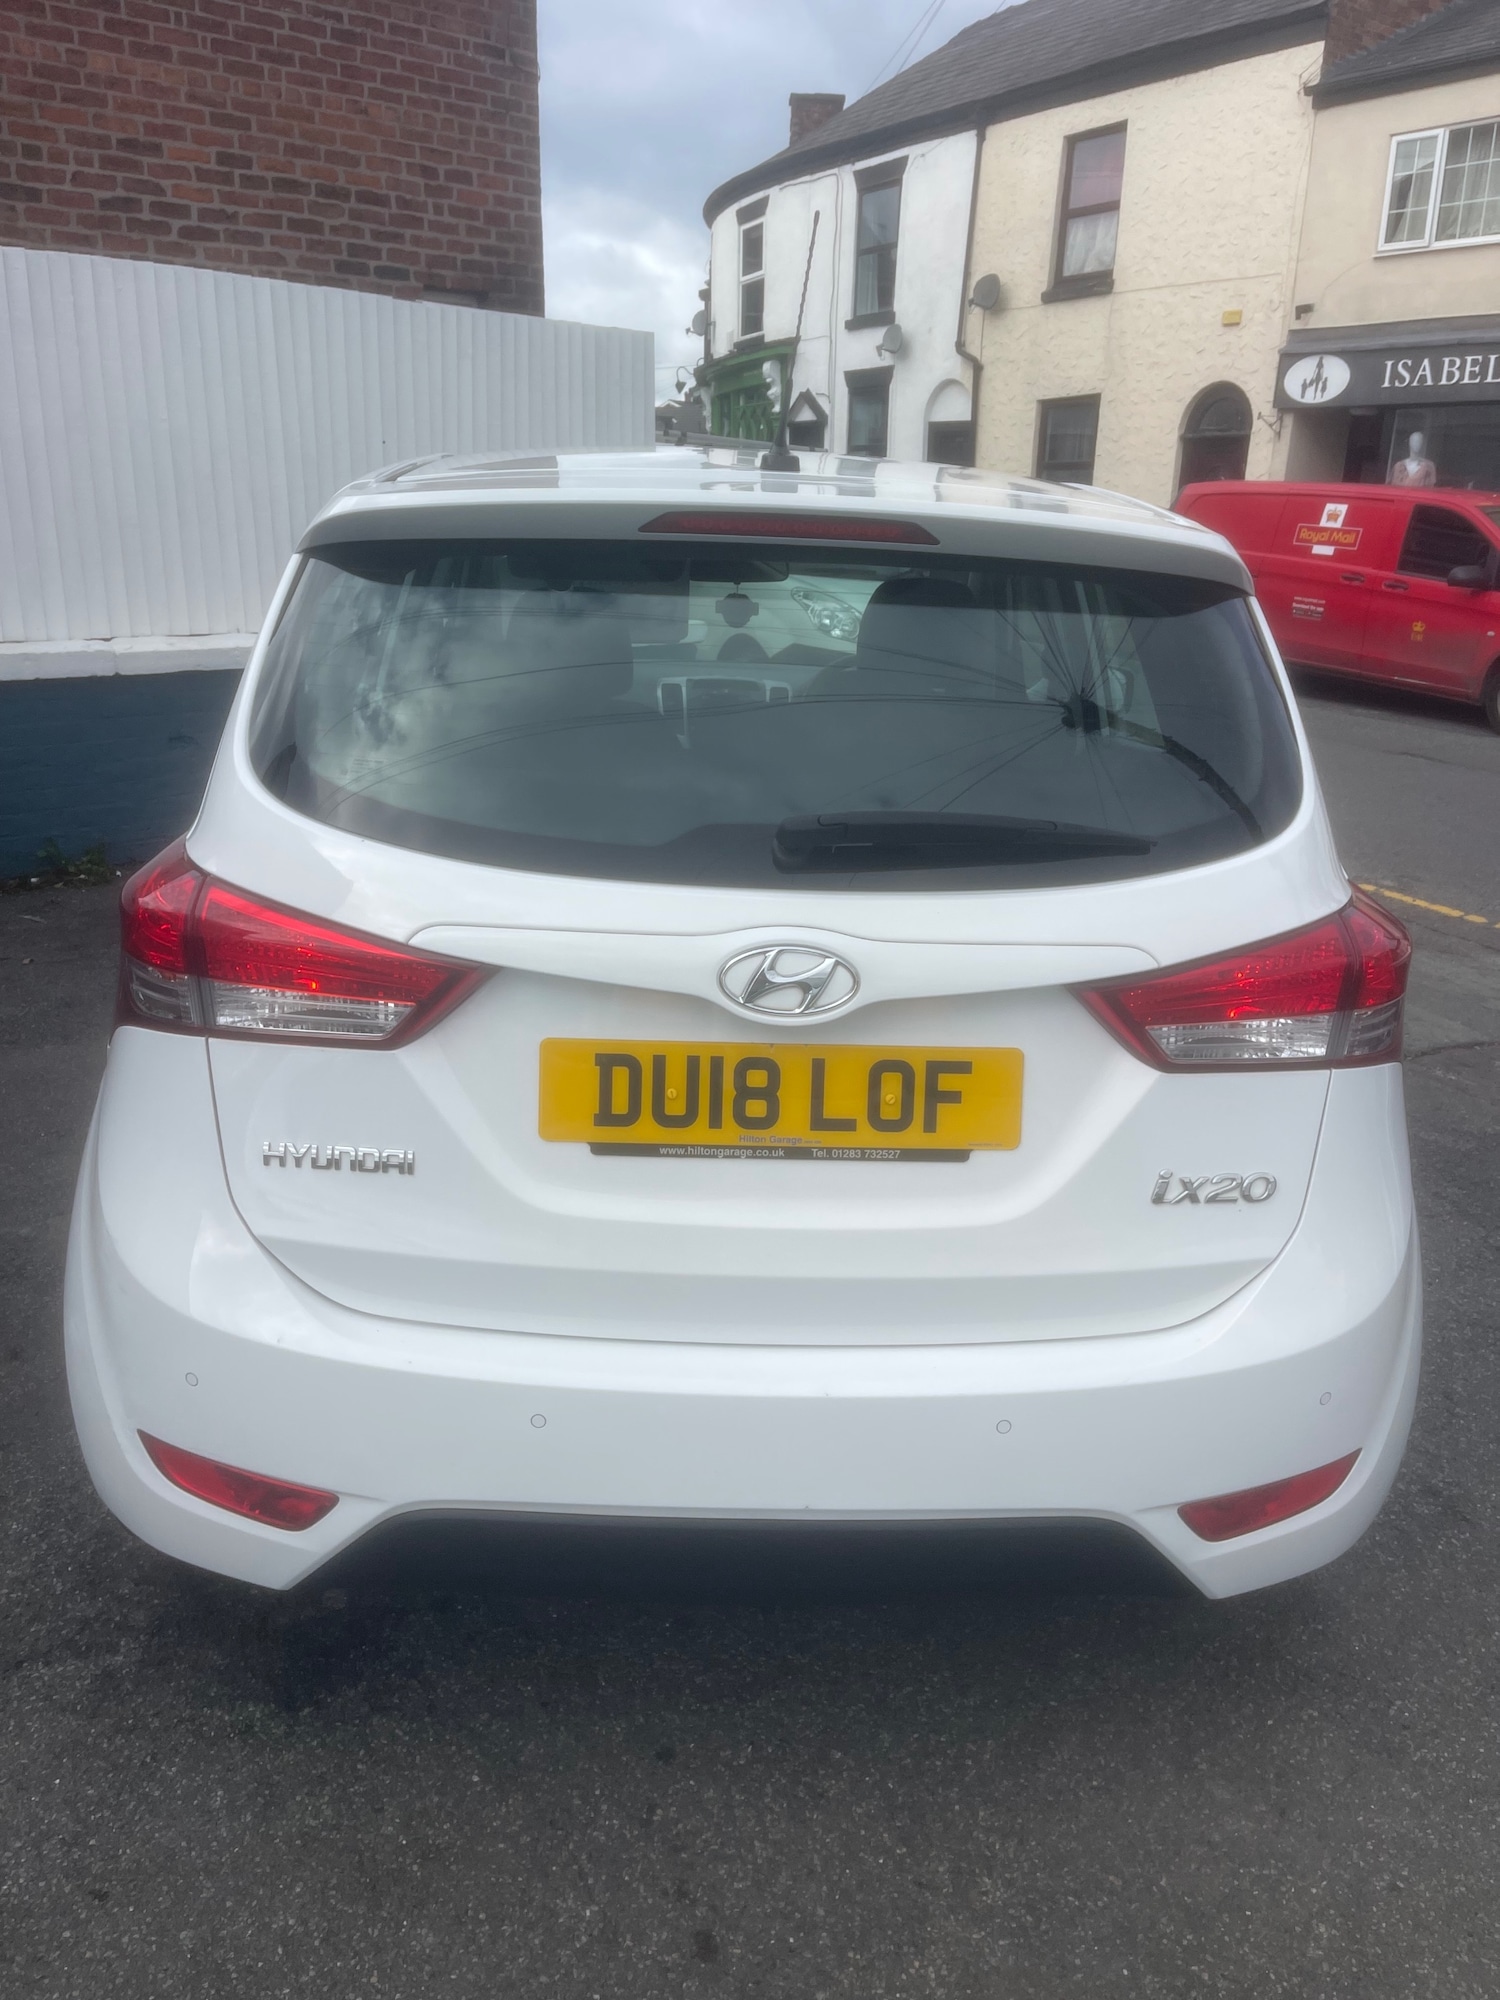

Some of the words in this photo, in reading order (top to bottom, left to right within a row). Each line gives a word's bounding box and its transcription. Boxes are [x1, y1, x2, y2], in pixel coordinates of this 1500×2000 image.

[1299, 527, 1330, 543] Royal
[1330, 530, 1356, 543] Mail
[593, 1053, 781, 1131] DU18
[810, 1057, 973, 1134] LOF
[739, 1134, 766, 1144] Hilton
[769, 1135, 803, 1146] Garage
[262, 1141, 415, 1175] HYUNDAI
[659, 1146, 785, 1159] www.hiltongarage.co.uk
[811, 1148, 829, 1158] Tel.
[832, 1149, 861, 1159] 01283
[864, 1150, 900, 1160] 732527
[1151, 1168, 1277, 1204] ix20
